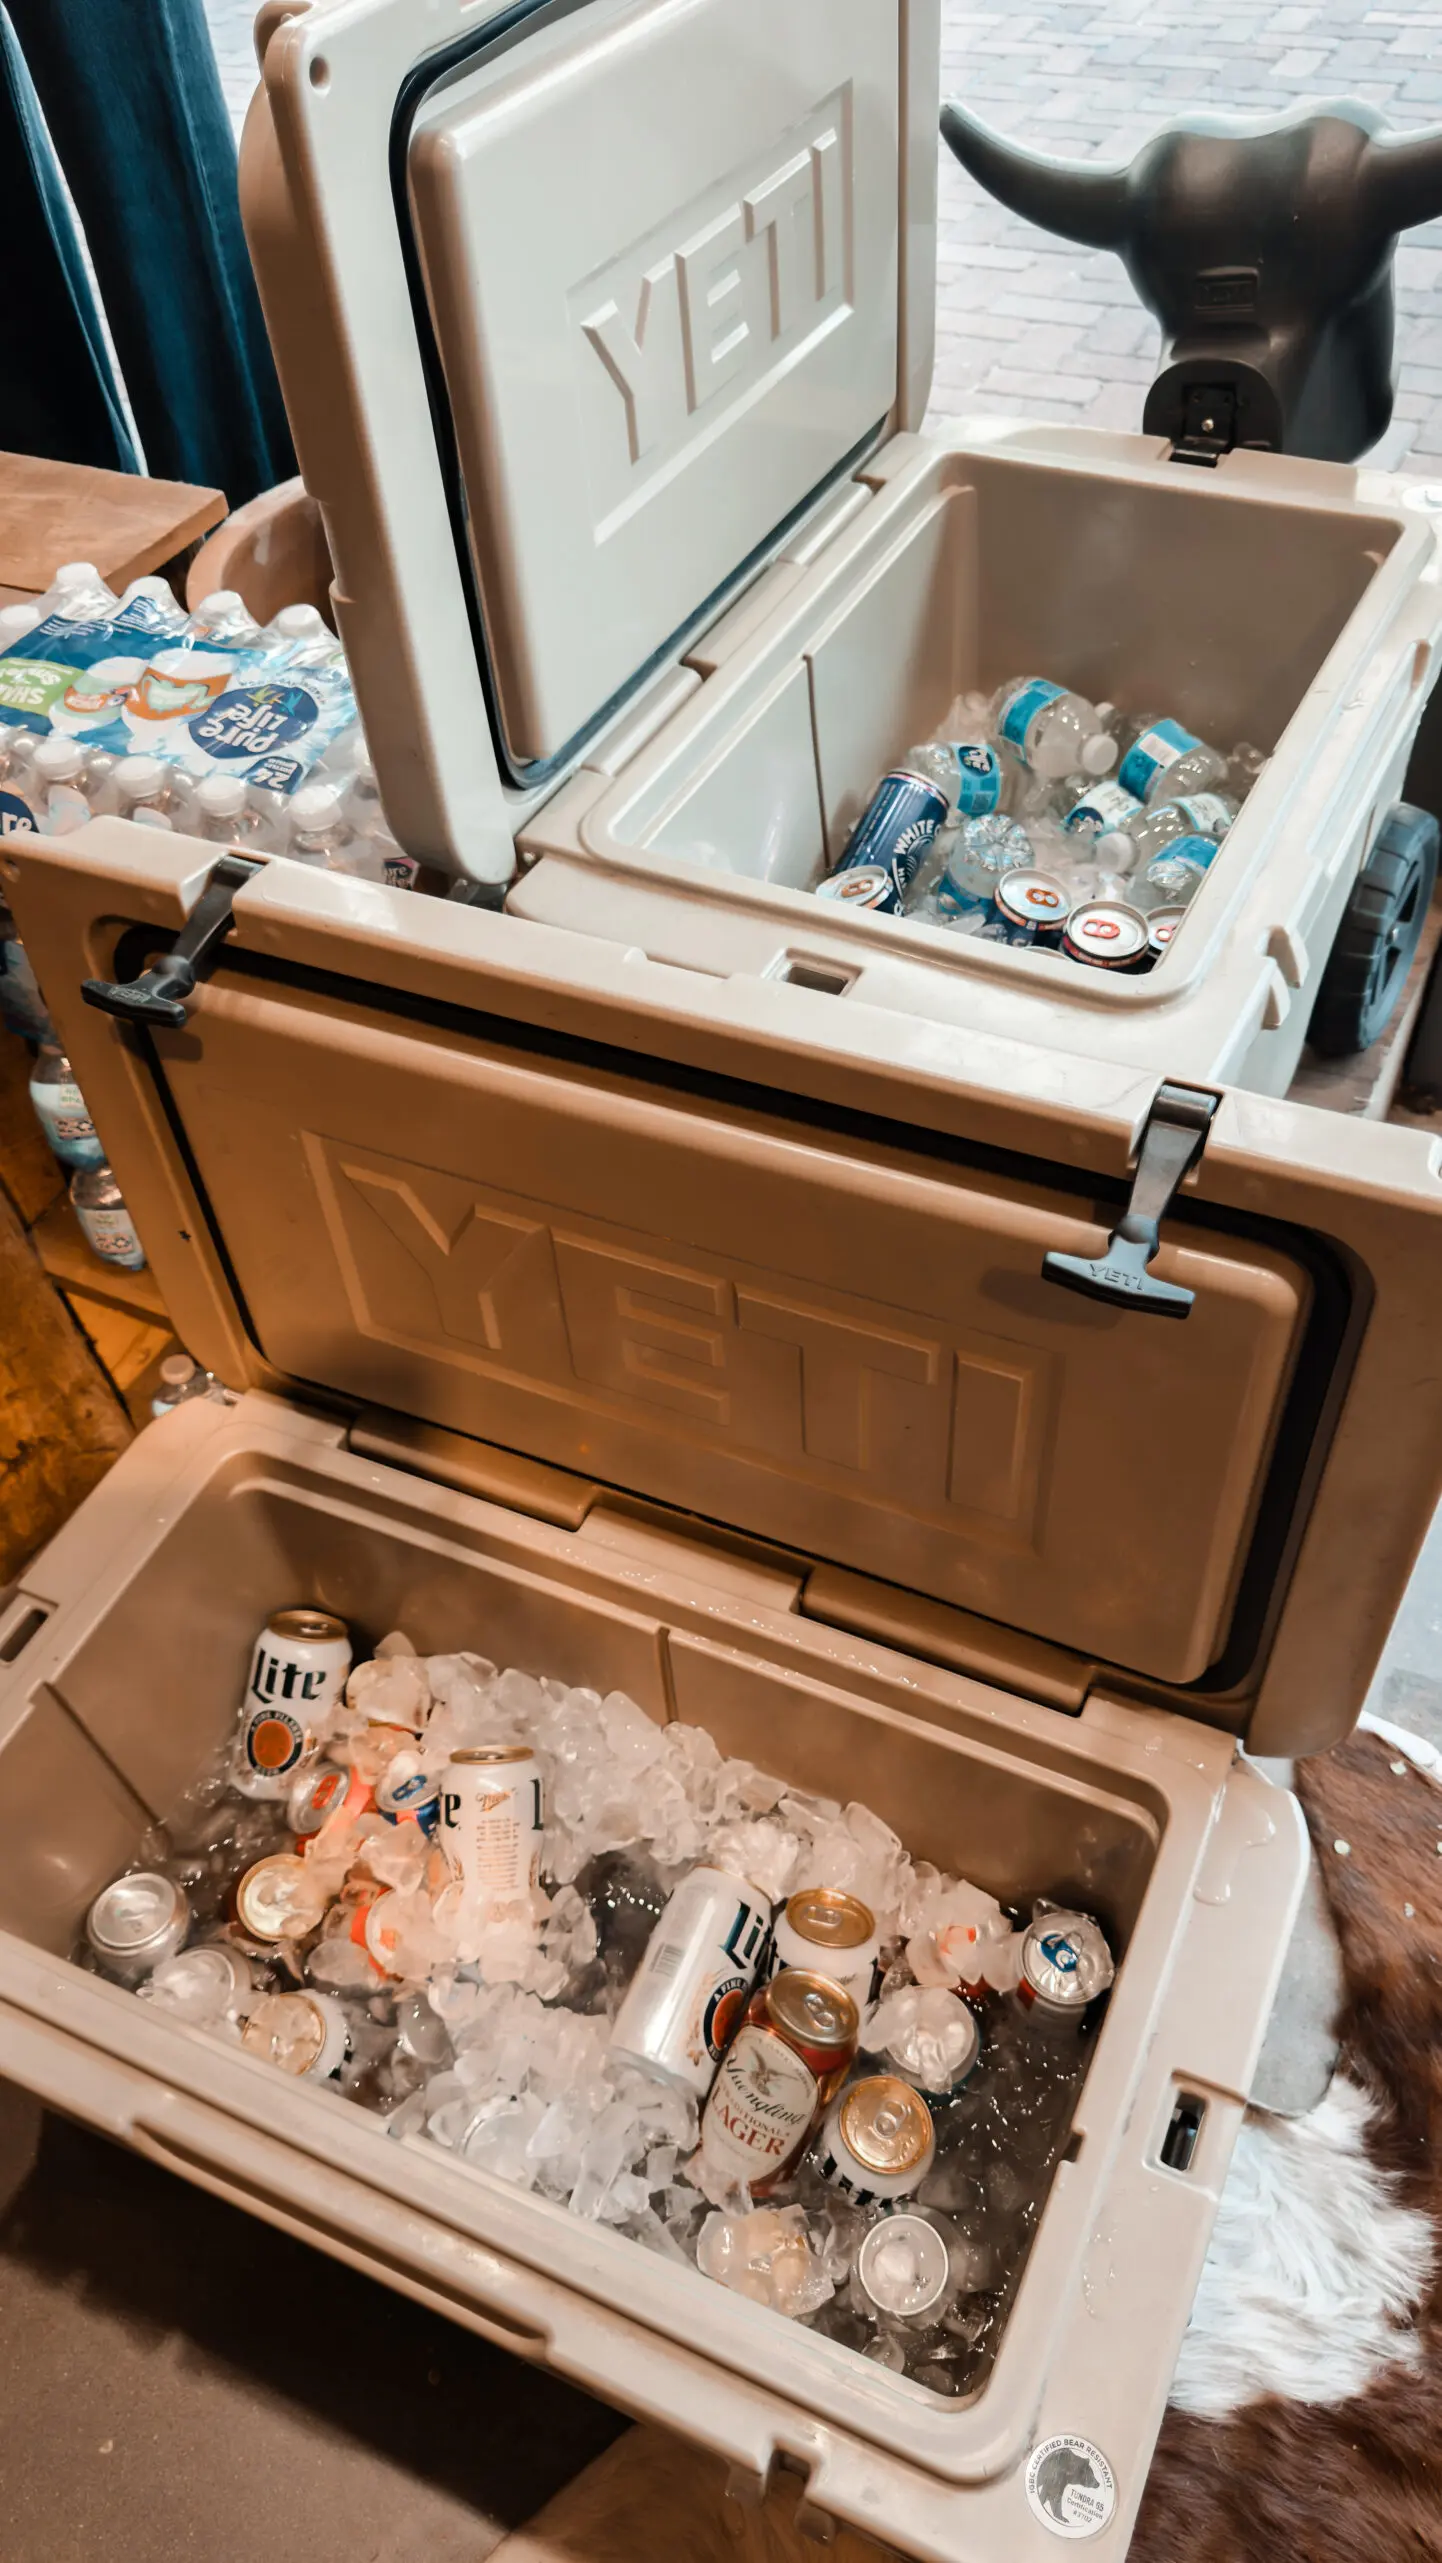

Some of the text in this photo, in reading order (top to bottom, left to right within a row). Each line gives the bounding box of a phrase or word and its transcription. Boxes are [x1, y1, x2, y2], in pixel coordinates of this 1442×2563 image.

[580, 126, 839, 468] YETI
[893, 819, 935, 855] WHITE
[1089, 1263, 1143, 1290] YETI
[341, 1160, 1031, 1520] YETI
[251, 1648, 327, 1705] Lite
[726, 2055, 807, 2126] Yuengling
[711, 2085, 785, 2156] LAGER
[1032, 2440, 1062, 2470] CERTIFIED
[1063, 2438, 1085, 2450] BEAR
[1085, 2446, 1113, 2489] RESISTANT
[1066, 2497, 1103, 2520] Certification
[1070, 2488, 1095, 2507] TUNDRA
